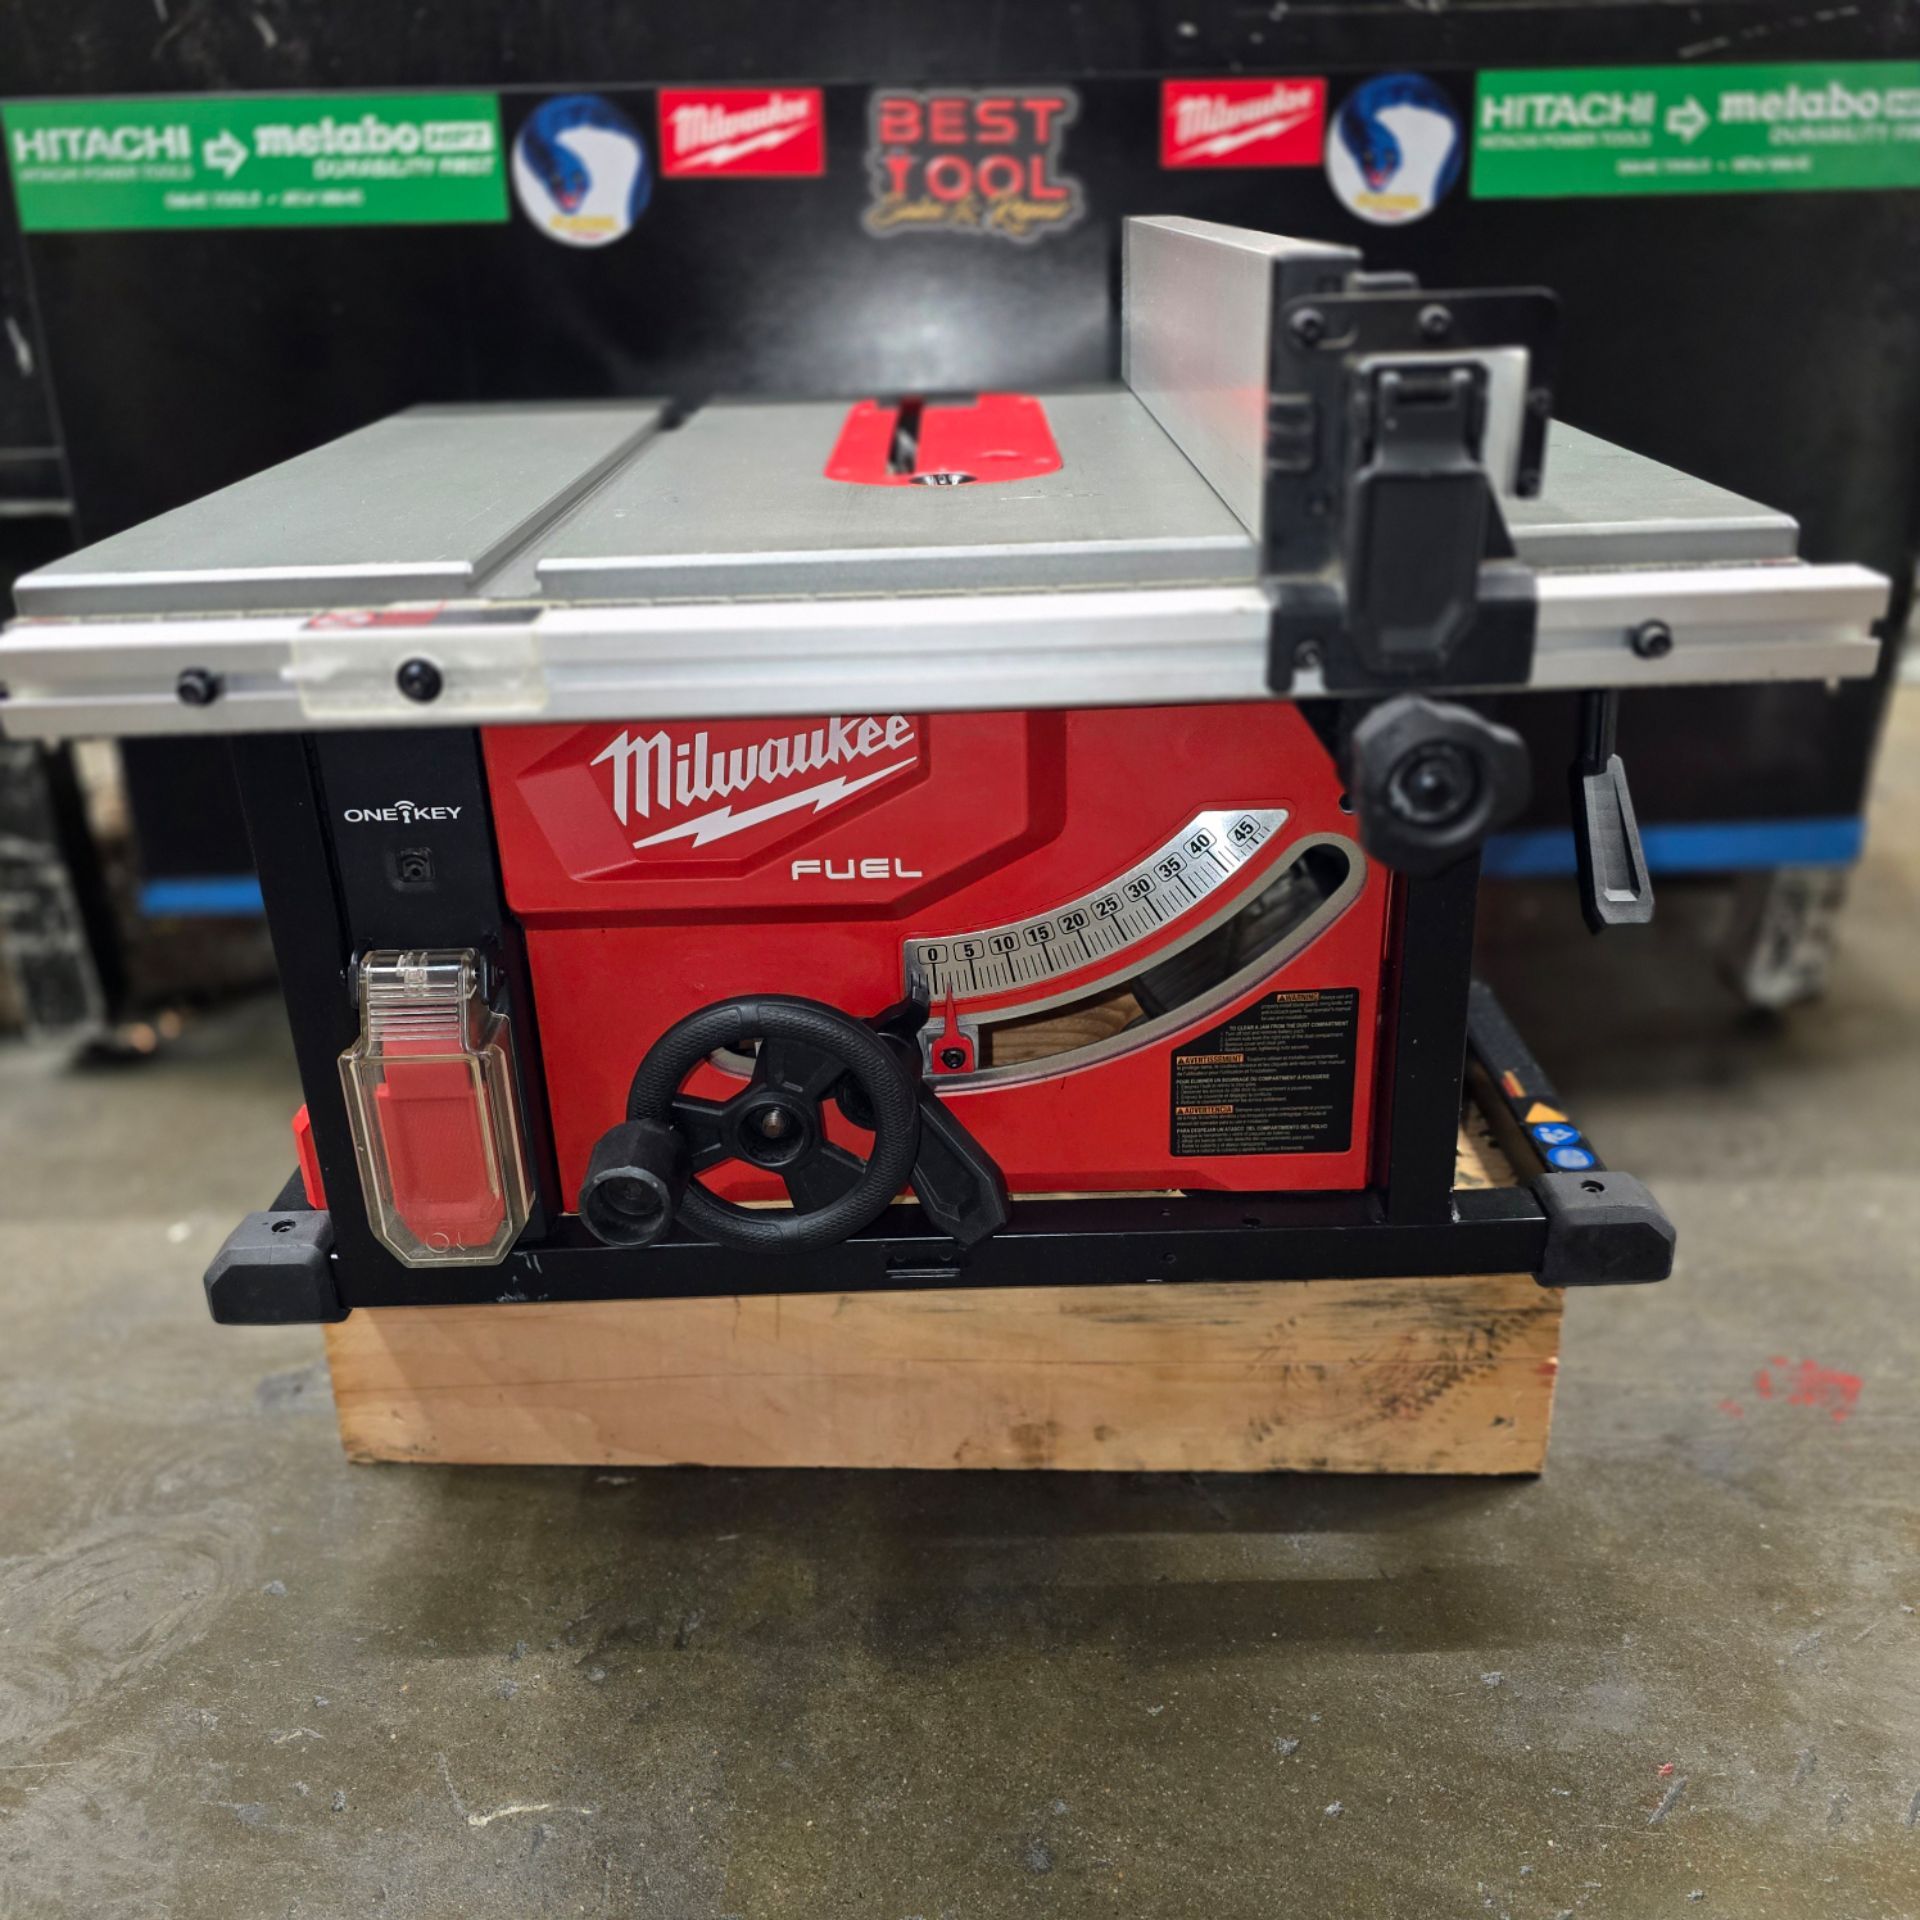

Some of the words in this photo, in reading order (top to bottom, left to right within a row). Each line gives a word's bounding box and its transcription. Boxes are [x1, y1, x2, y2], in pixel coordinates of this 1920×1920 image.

[879, 98, 1065, 145] BEST
[1482, 92, 1656, 129] HITACHI
[1718, 83, 1880, 123] metabo
[13, 124, 192, 163] HITACHI
[253, 113, 421, 157] metabo
[882, 148, 1070, 202] TOOL
[590, 715, 915, 825] Milwaukee
[791, 858, 923, 881] FUEL
[928, 946, 937, 961] 0
[964, 944, 974, 958] 5
[994, 936, 1014, 952] 10
[1028, 926, 1049, 942] 15
[1063, 913, 1085, 930] 20
[1096, 898, 1118, 916] 25
[1128, 878, 1150, 898] 30
[1158, 857, 1181, 878] 35
[1188, 834, 1210, 856] 40
[1234, 820, 1255, 843] 45
